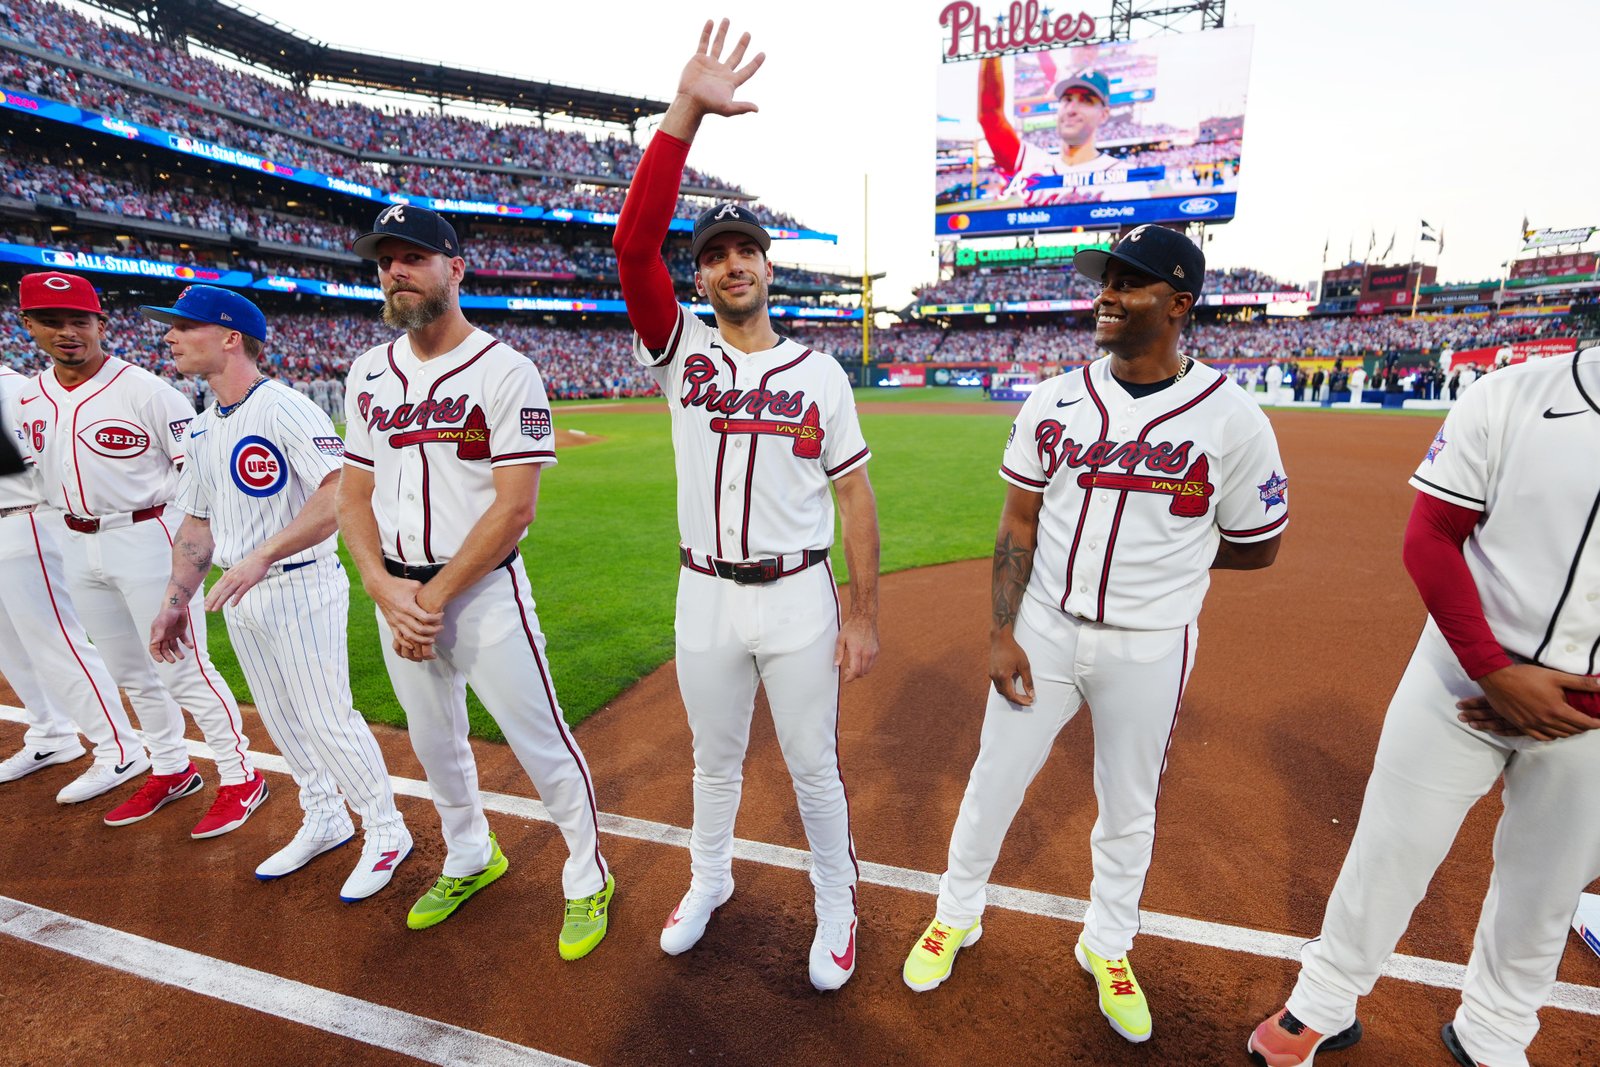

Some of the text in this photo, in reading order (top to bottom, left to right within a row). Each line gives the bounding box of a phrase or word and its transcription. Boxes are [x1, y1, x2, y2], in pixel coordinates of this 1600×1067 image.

[939, 0, 1096, 57] Phillies
[380, 204, 405, 225] A
[714, 203, 740, 221] A
[1017, 210, 1051, 224] Mobile
[1090, 206, 1136, 219] abbvie
[104, 255, 139, 273] STAR
[139, 259, 175, 277] GAME
[1372, 275, 1404, 286] GIANT
[681, 353, 805, 418] Braves
[522, 411, 548, 420] USA
[98, 431, 148, 447] REDS
[522, 425, 550, 435] 250
[1035, 418, 1194, 479] Braves
[238, 446, 278, 487] CUBS
[371, 850, 399, 872] N
